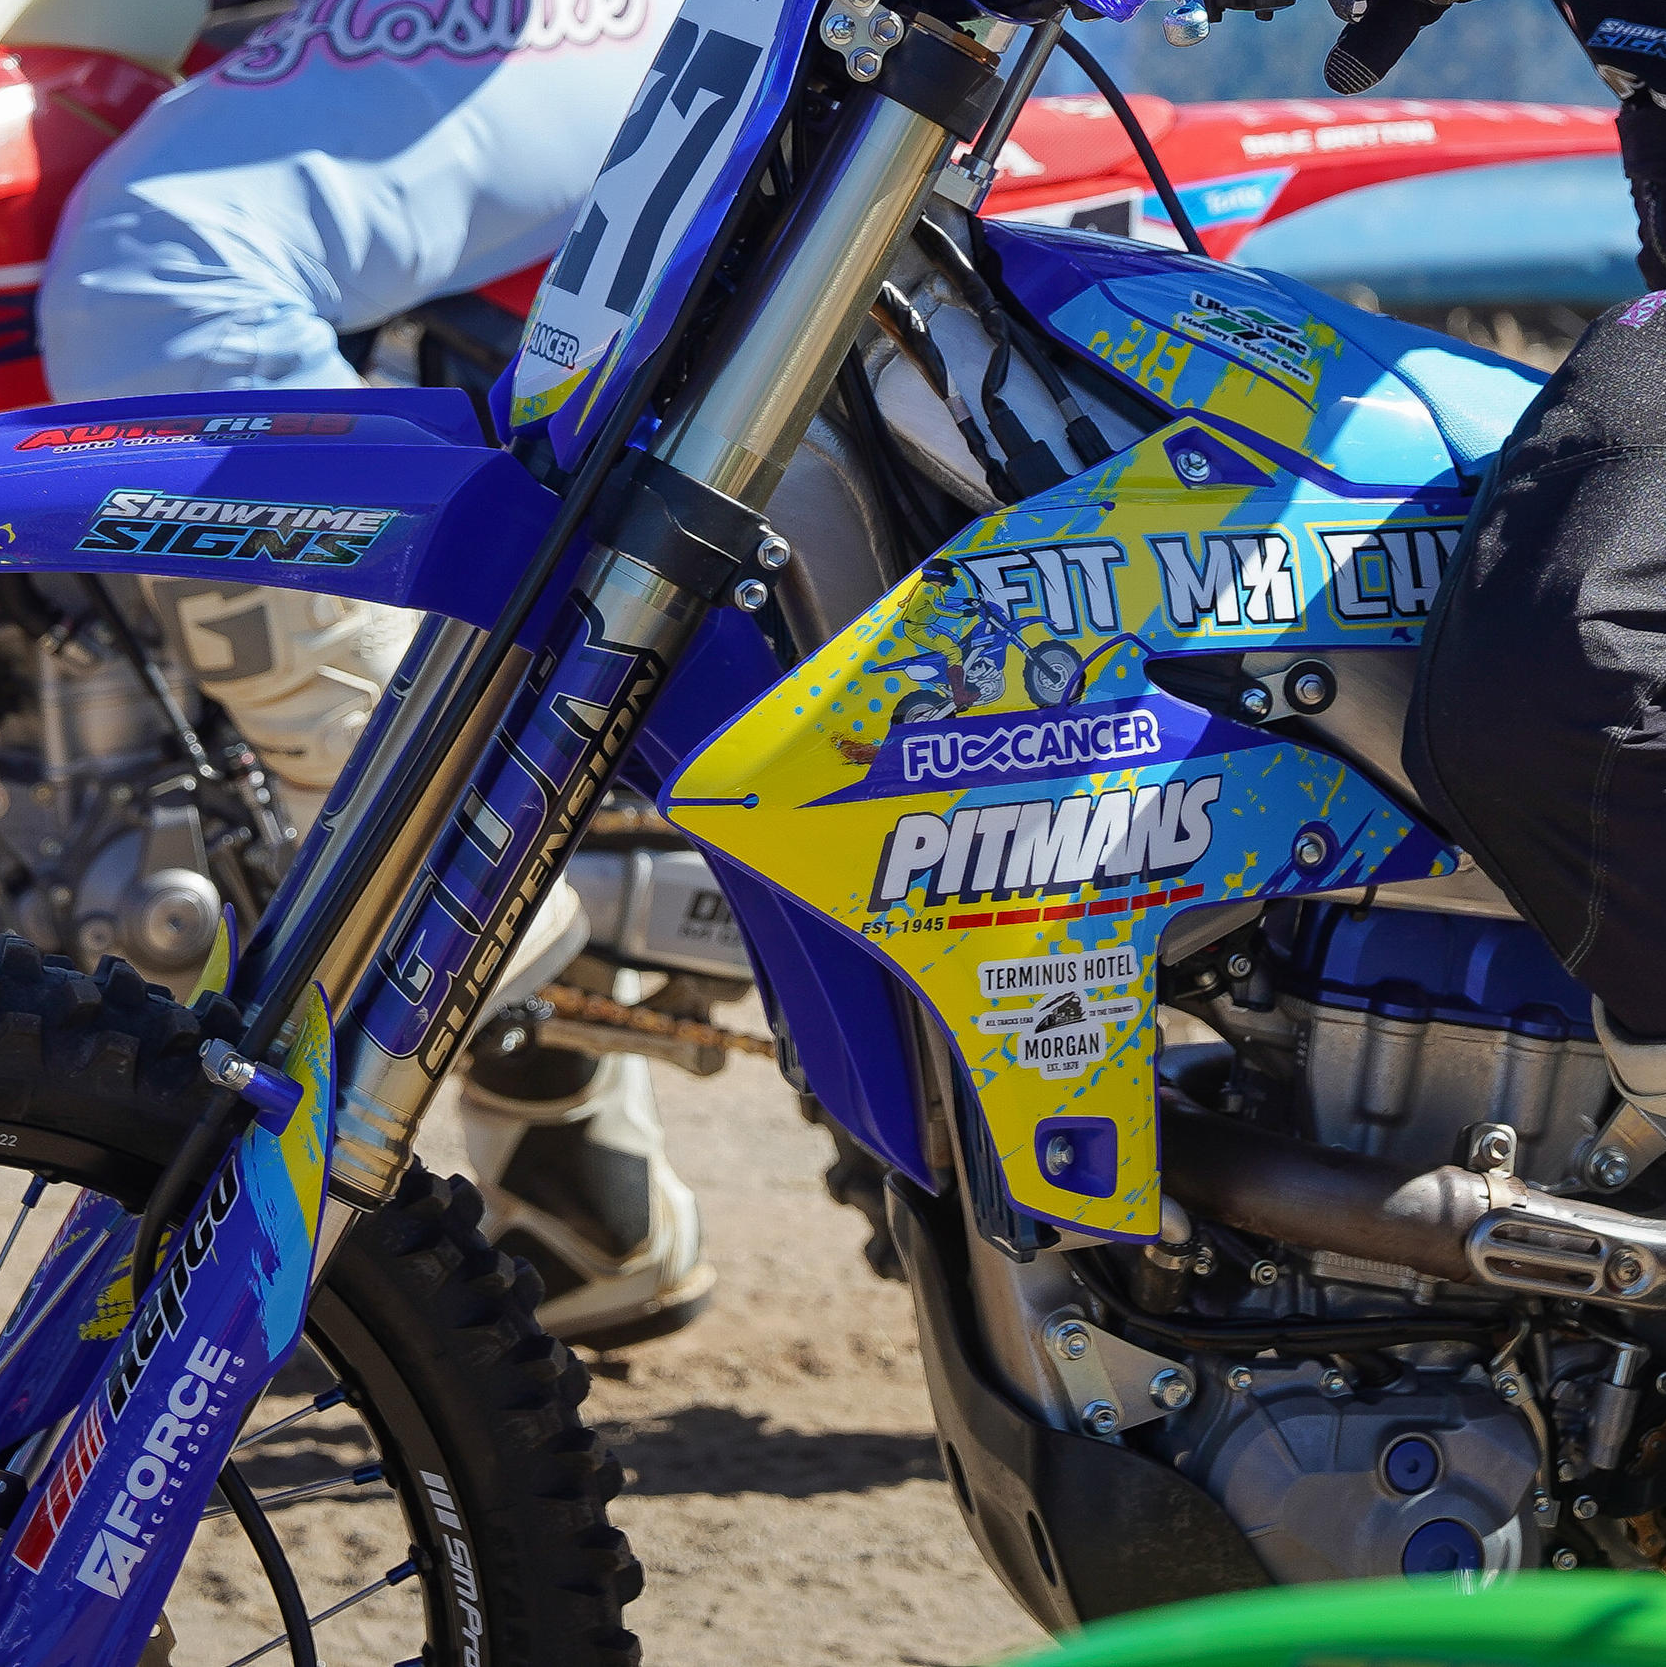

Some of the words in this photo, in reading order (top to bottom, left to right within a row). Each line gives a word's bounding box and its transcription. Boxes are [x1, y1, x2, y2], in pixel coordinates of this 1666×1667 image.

[1243, 341, 1279, 364] Golden
[101, 492, 389, 533] SHOWTIME
[73, 517, 373, 566] SIGNS
[963, 545, 1130, 637] FIT
[1152, 531, 1299, 628] MX
[876, 775, 1221, 904] PITMANS
[424, 656, 661, 1081] SUSPENSION
[861, 920, 894, 935] EST
[901, 916, 944, 934] 1945
[985, 960, 1077, 991] TERMINUS
[1083, 953, 1134, 982] HOTEL
[1024, 1032, 1100, 1062] MORGAN
[141, 1353, 246, 1545] ACCESSORIES
